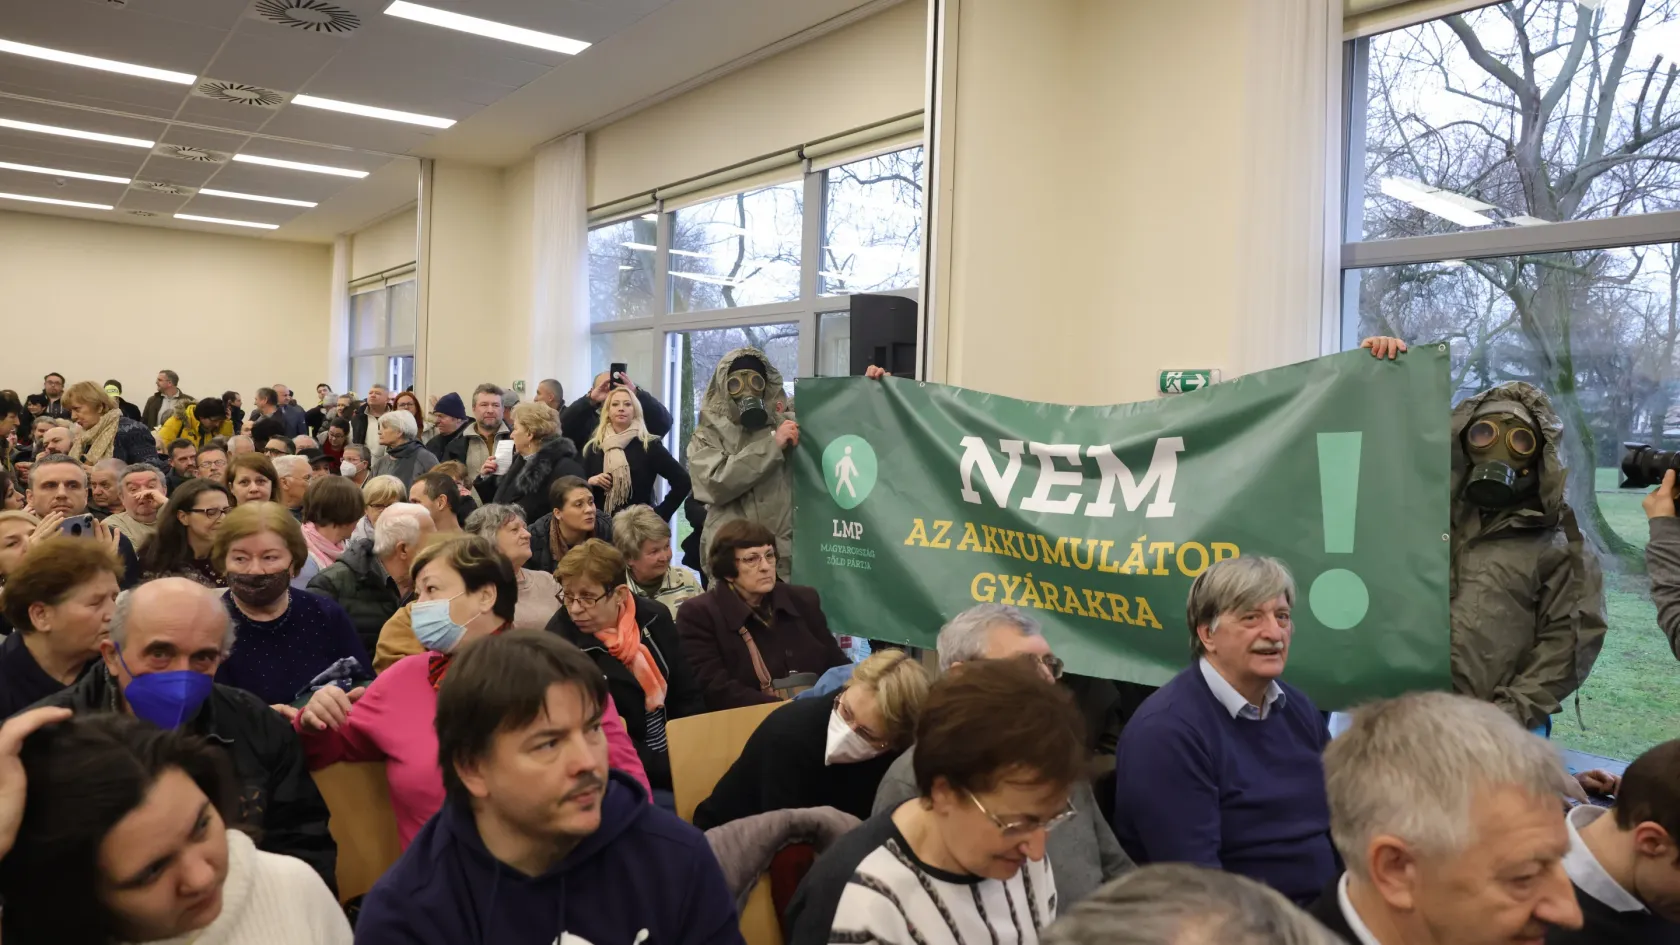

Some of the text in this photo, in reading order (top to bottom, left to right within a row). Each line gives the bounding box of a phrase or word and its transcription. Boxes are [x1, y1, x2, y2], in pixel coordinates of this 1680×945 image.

[959, 435, 1185, 518] NEM
[832, 519, 864, 540] LMP
[904, 518, 954, 549] AZ
[970, 572, 1163, 630] GYÁRAKRA
